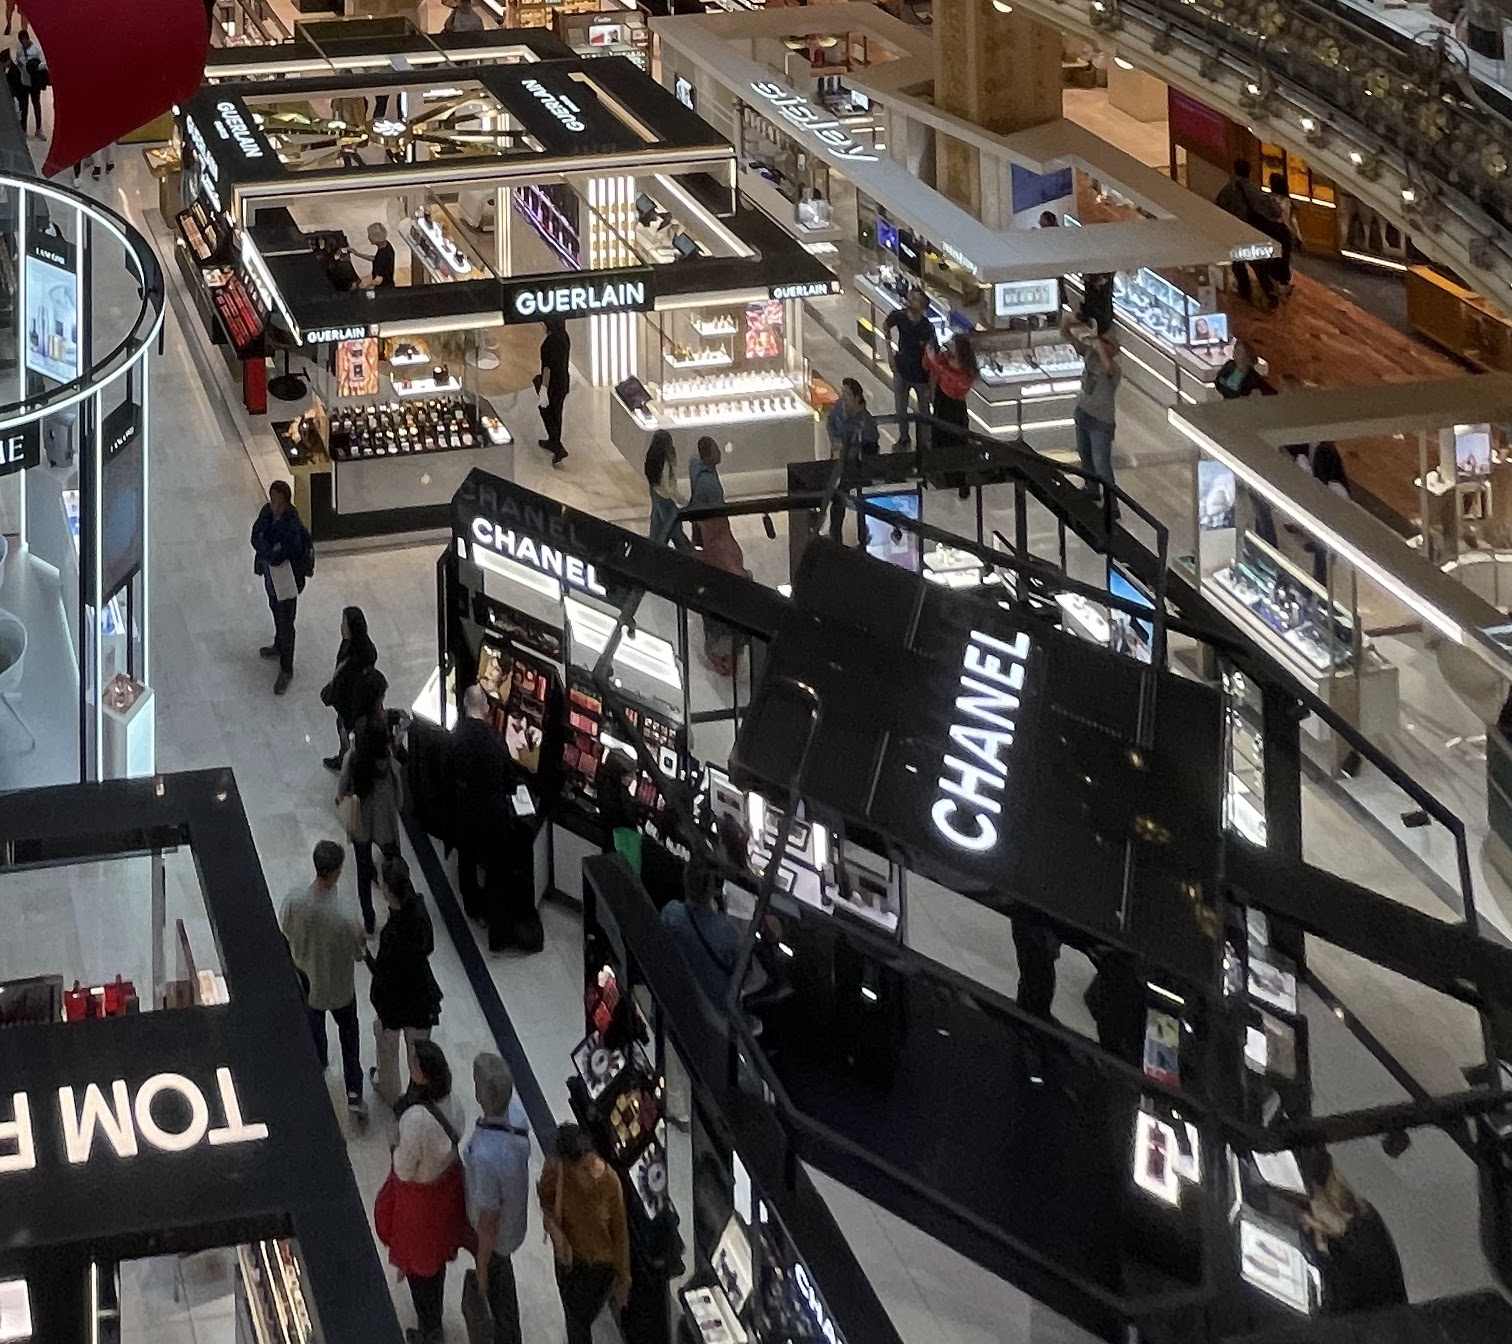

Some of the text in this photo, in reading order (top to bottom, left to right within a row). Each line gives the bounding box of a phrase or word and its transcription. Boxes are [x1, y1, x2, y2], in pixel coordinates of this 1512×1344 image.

[216, 101, 263, 158] GUERLAIN
[521, 79, 585, 132] GUERLAIN
[750, 82, 879, 161] sisley
[515, 282, 646, 315] GUERLAIN
[773, 282, 828, 299] GUERLAIN
[306, 326, 365, 344] GUERLAIN
[472, 517, 607, 597] CHANEL
[931, 629, 1040, 851] CHANEL
[59, 1067, 269, 1164] TOM
